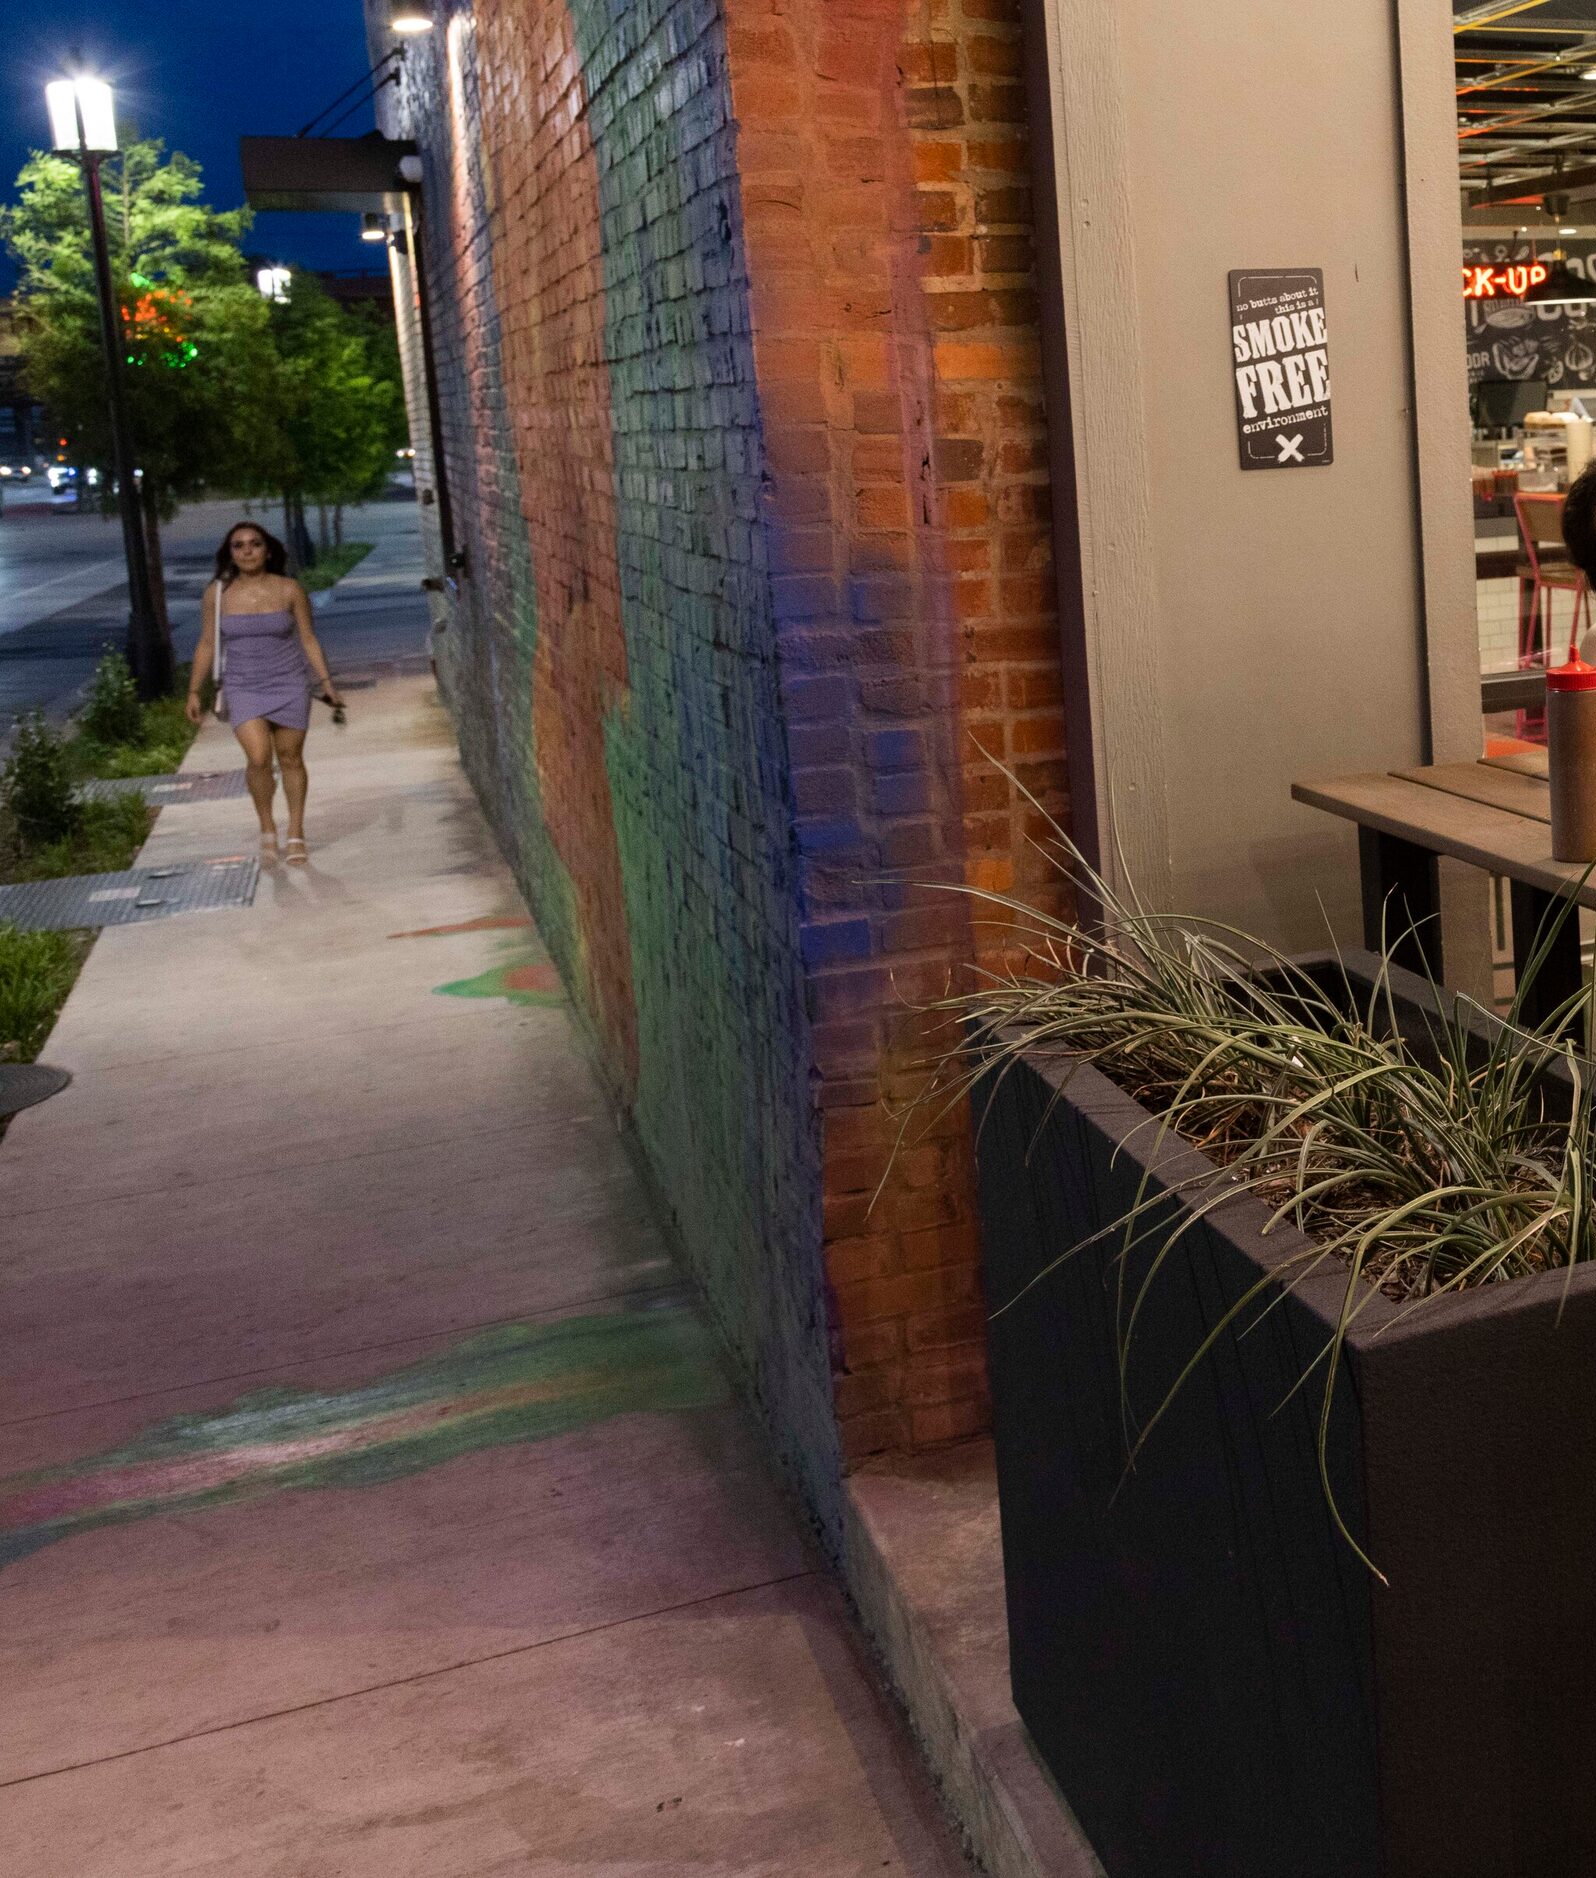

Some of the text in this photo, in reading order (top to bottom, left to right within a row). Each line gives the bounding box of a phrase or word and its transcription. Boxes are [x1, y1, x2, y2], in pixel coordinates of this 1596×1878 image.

[1236, 287, 1319, 313] no butts about it
[1275, 303, 1295, 315] this
[1296, 301, 1307, 310] is
[1233, 307, 1328, 363] SMOKE
[1235, 349, 1331, 419] FREE
[1242, 405, 1329, 434] environment
